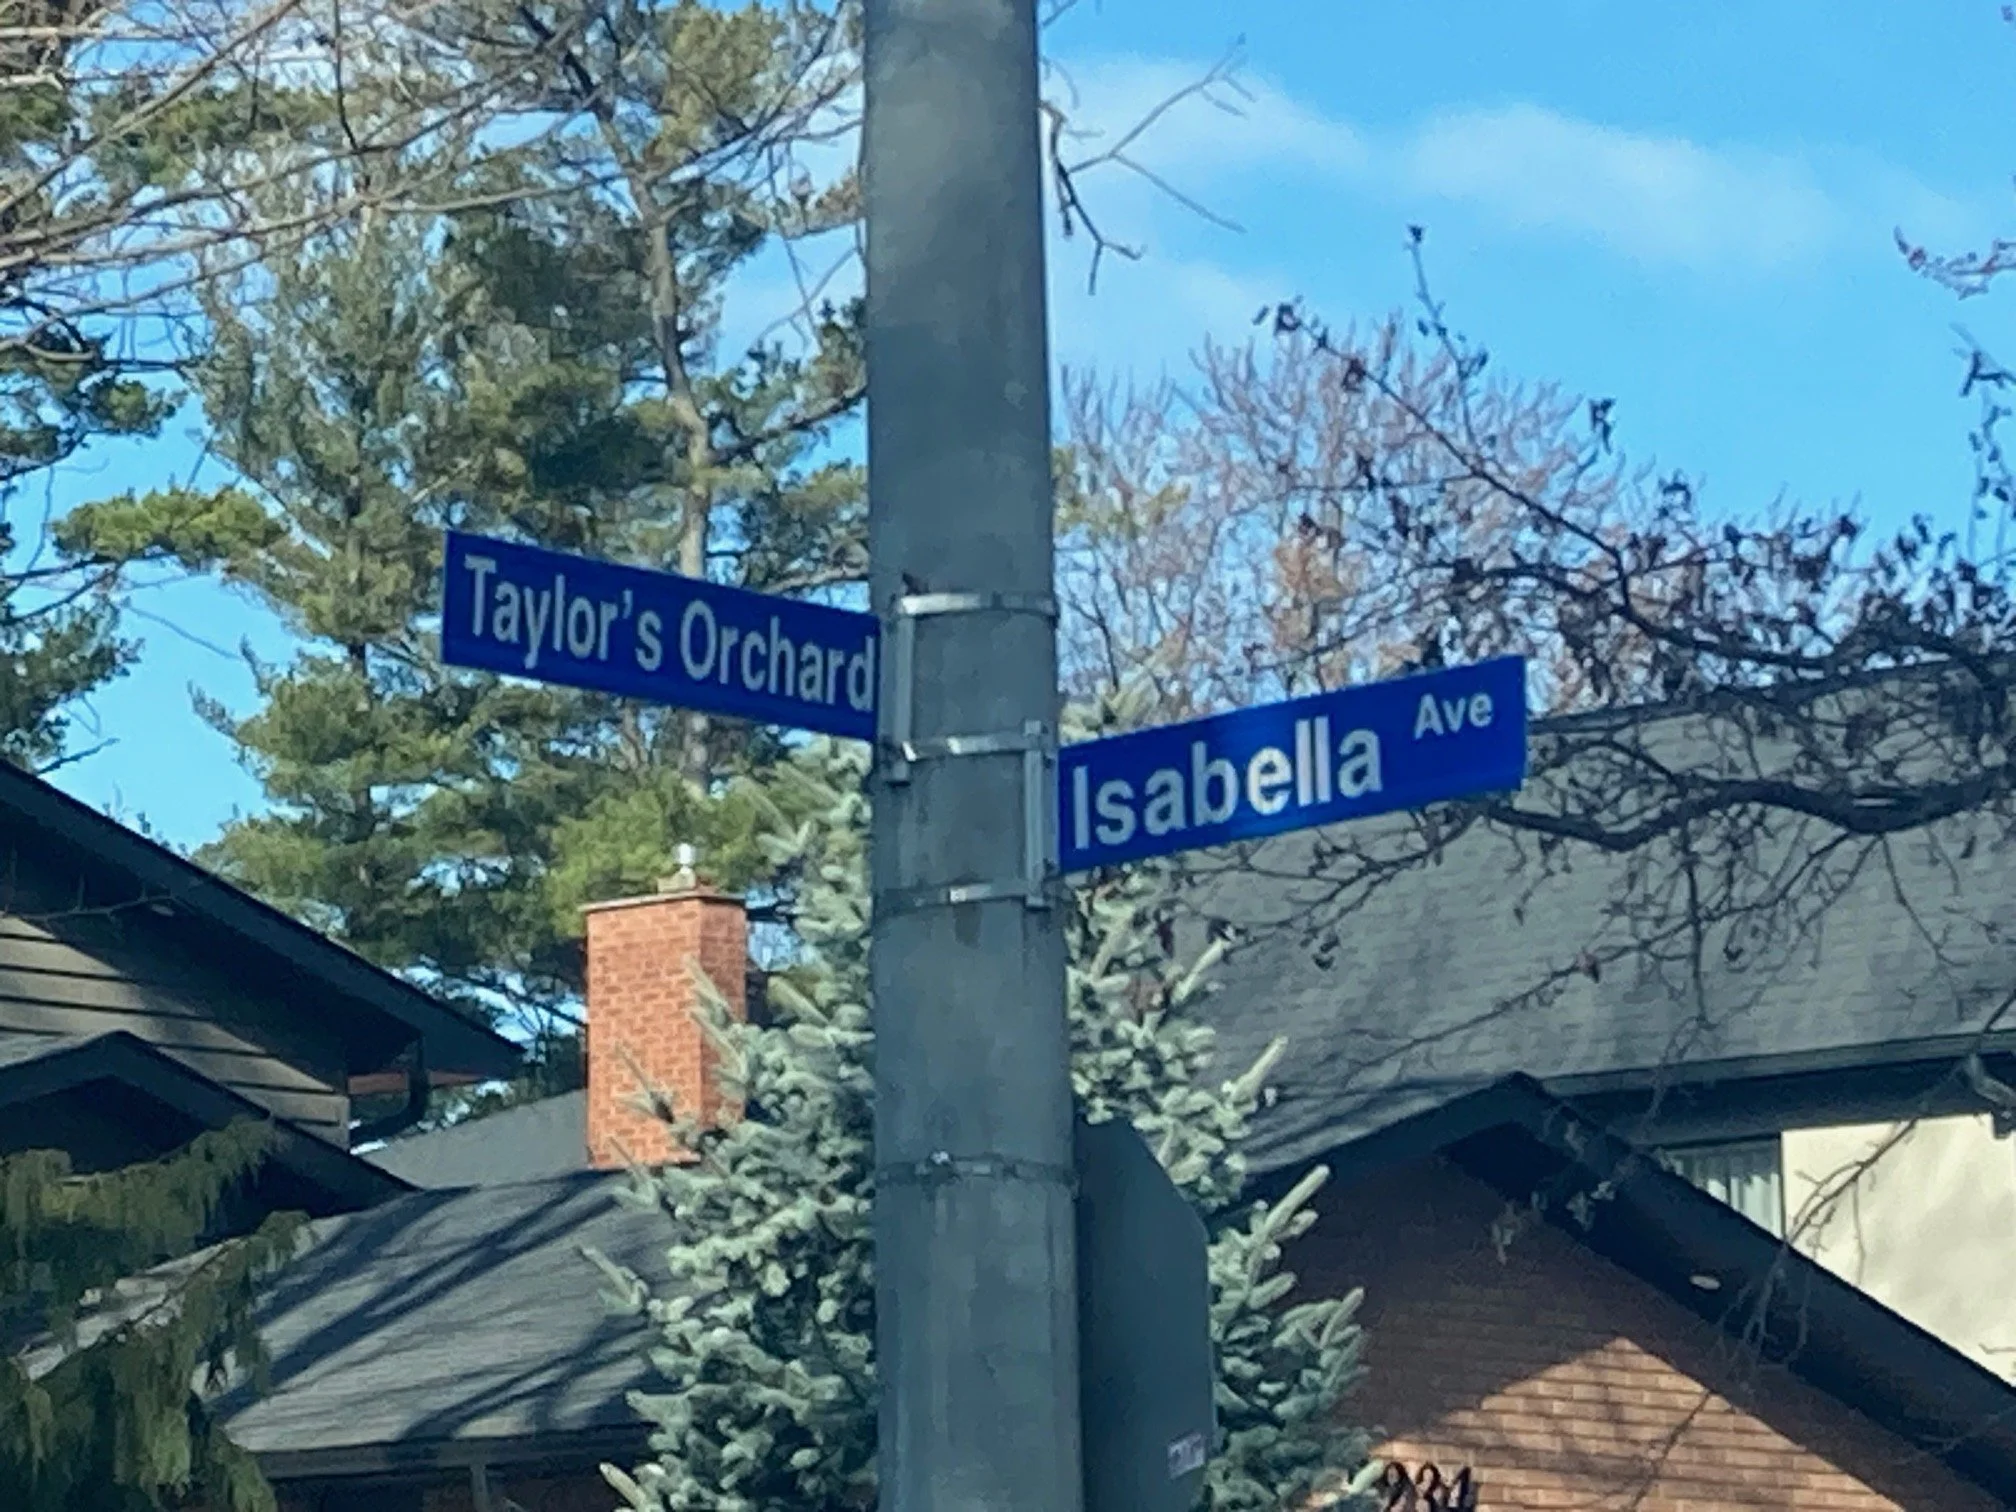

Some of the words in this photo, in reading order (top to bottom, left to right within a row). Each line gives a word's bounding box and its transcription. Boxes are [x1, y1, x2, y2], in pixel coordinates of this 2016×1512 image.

[464, 554, 663, 671] Taylor's
[680, 599, 875, 712] Orchard
[1072, 715, 1383, 850] Isabella
[1413, 692, 1493, 740] Ave
